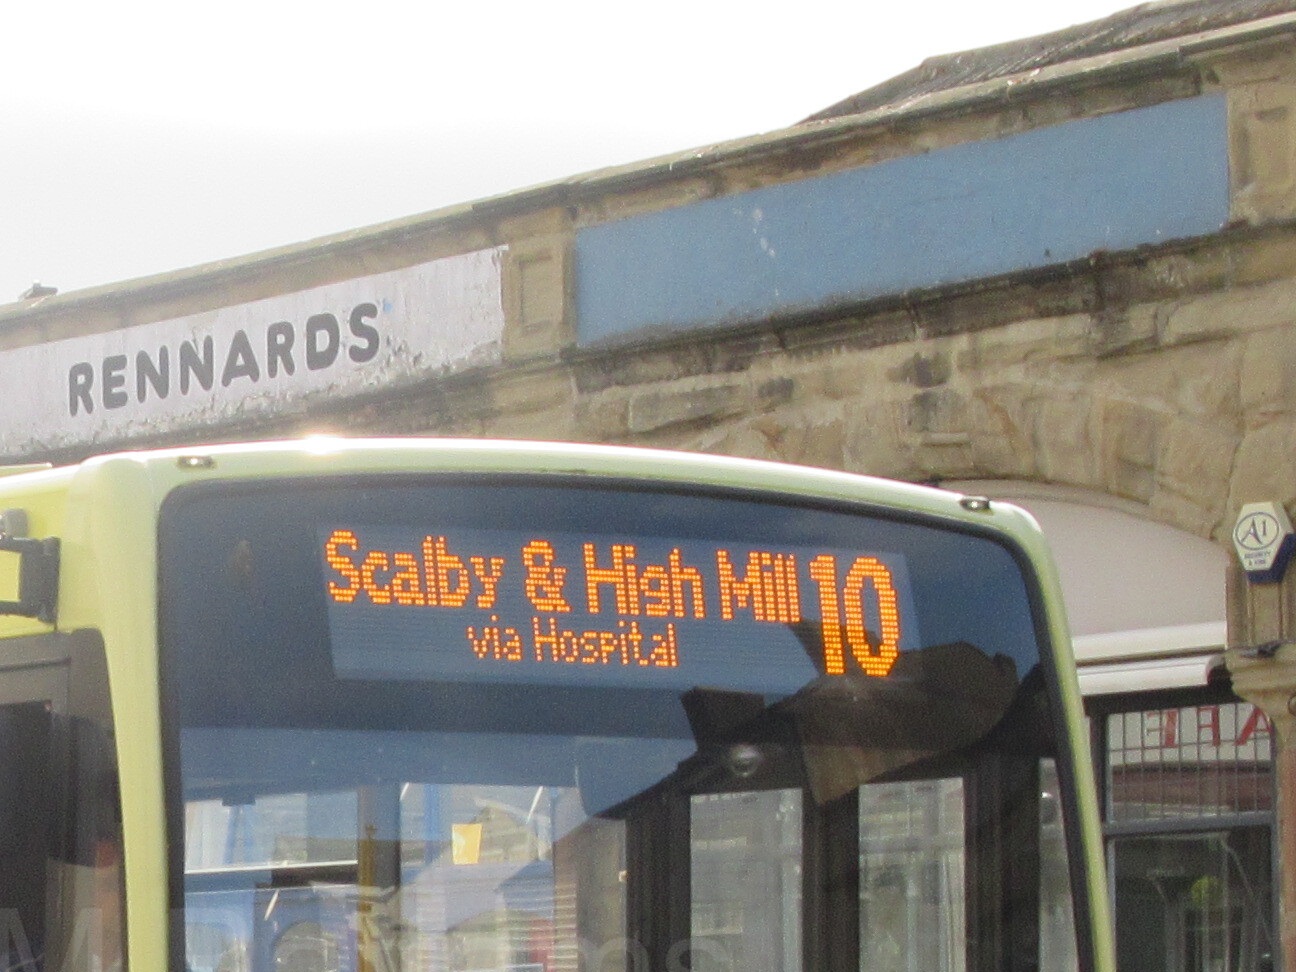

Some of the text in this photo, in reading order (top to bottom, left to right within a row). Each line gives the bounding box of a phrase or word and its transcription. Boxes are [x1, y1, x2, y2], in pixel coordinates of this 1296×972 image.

[68, 302, 381, 416] RENNARDS
[324, 529, 801, 624] Scalby & High Mill
[808, 553, 901, 677] 10
[467, 614, 679, 668] via Hospital
